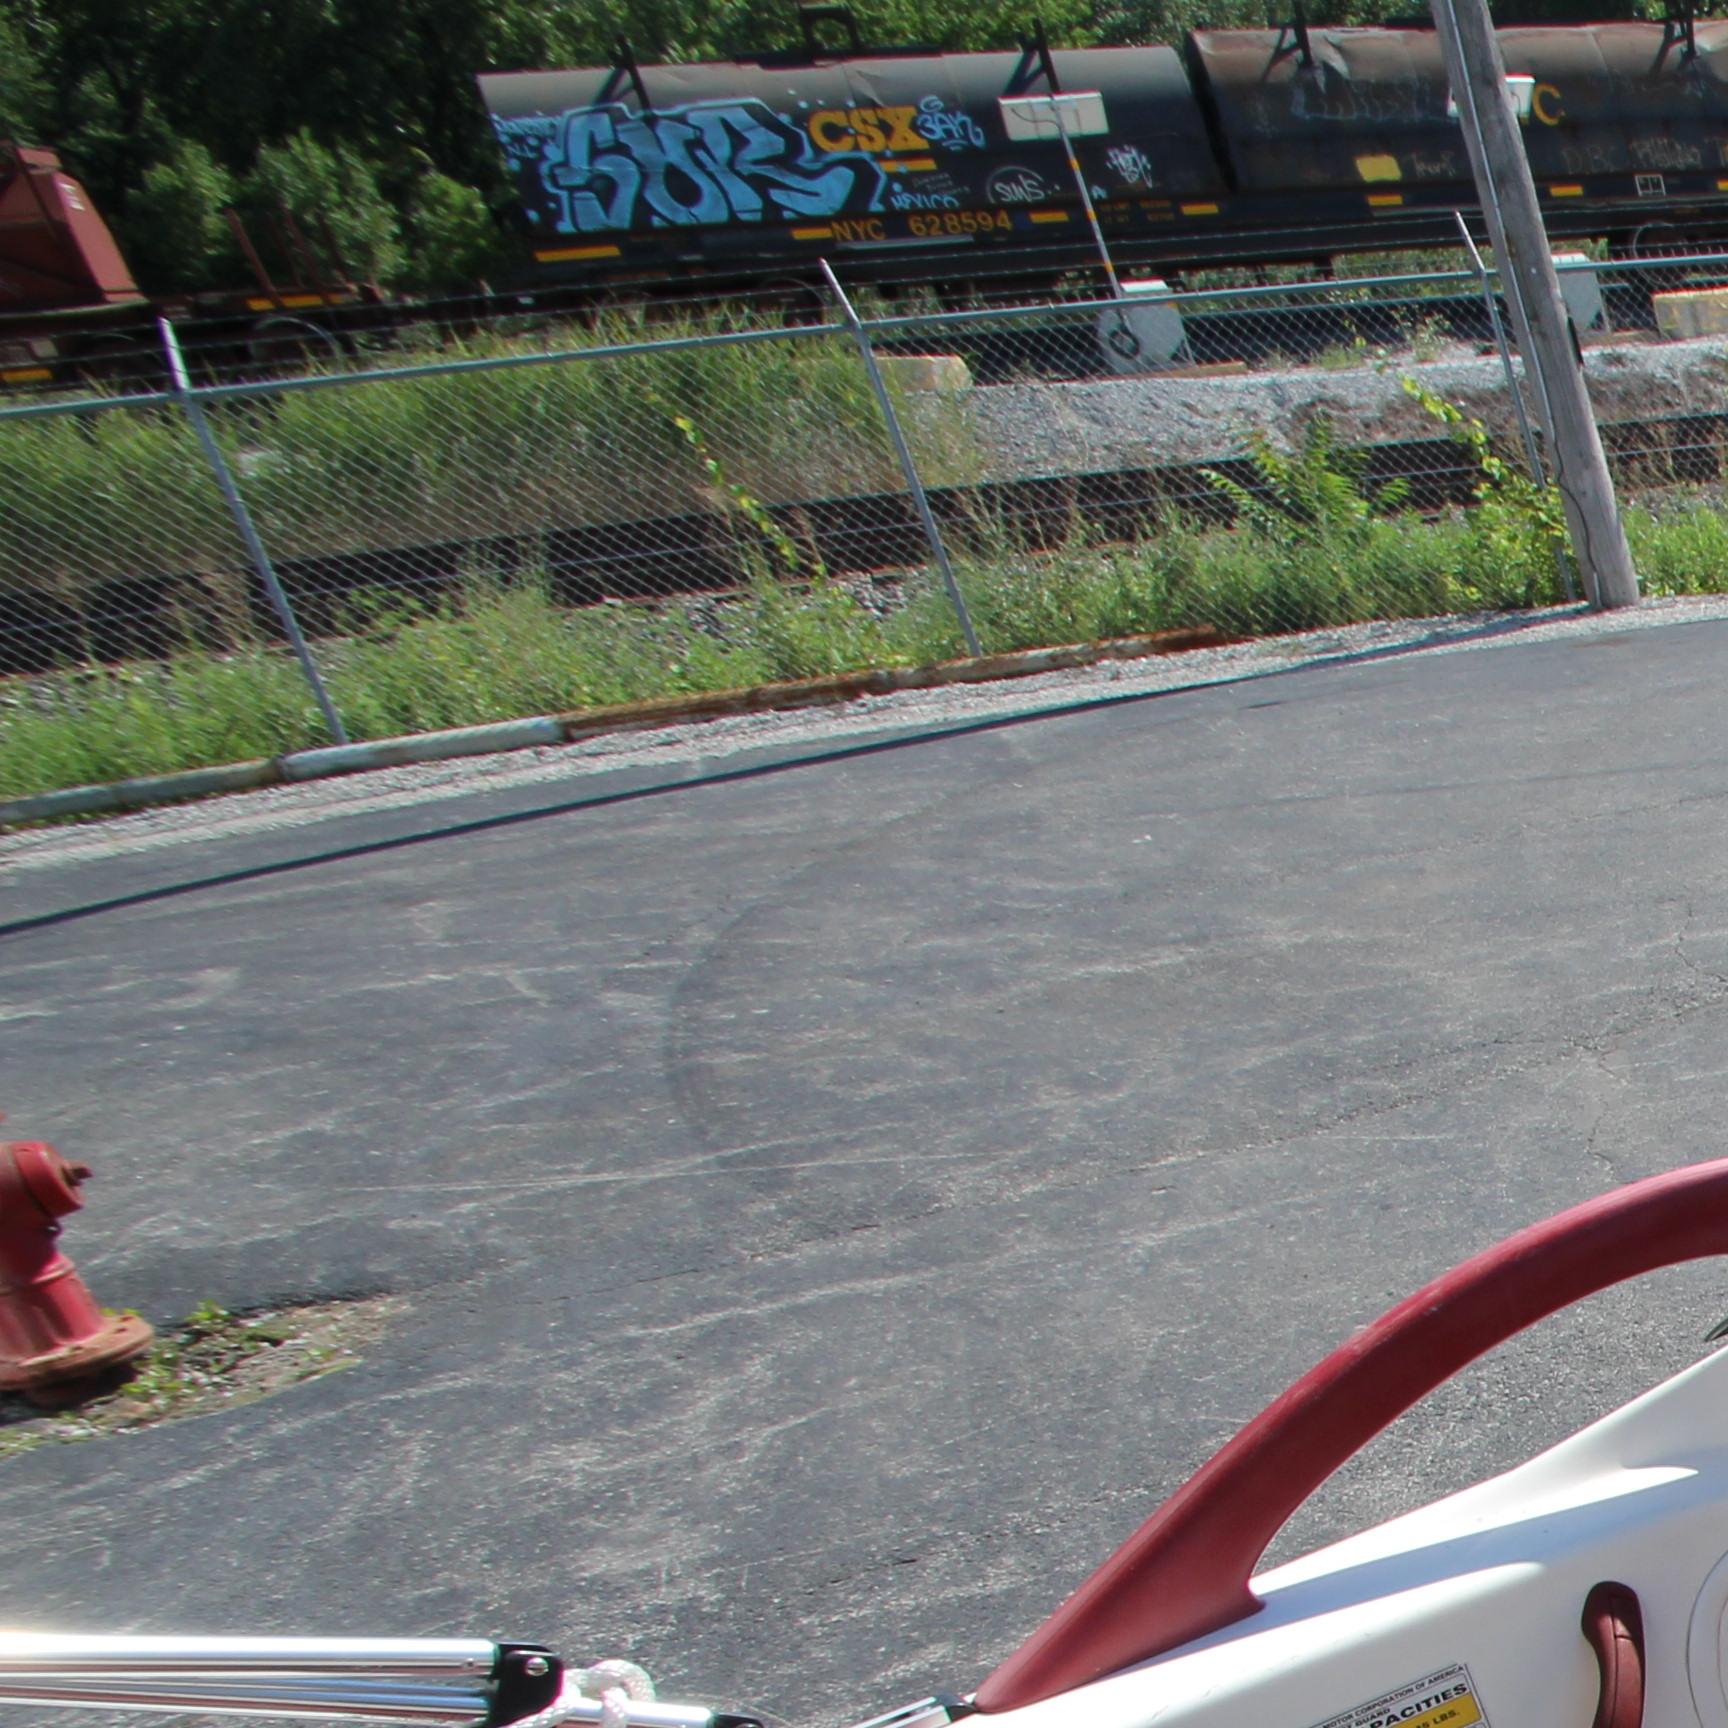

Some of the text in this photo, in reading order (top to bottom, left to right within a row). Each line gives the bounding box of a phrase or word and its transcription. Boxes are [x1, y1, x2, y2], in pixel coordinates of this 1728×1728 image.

[808, 106, 931, 152] CSX
[830, 211, 1013, 243] NYC 628594
[1354, 1686, 1415, 1717] CORPORATION
[1427, 1664, 1464, 1685] AMERICA
[1354, 1707, 1391, 1728] GUARD
